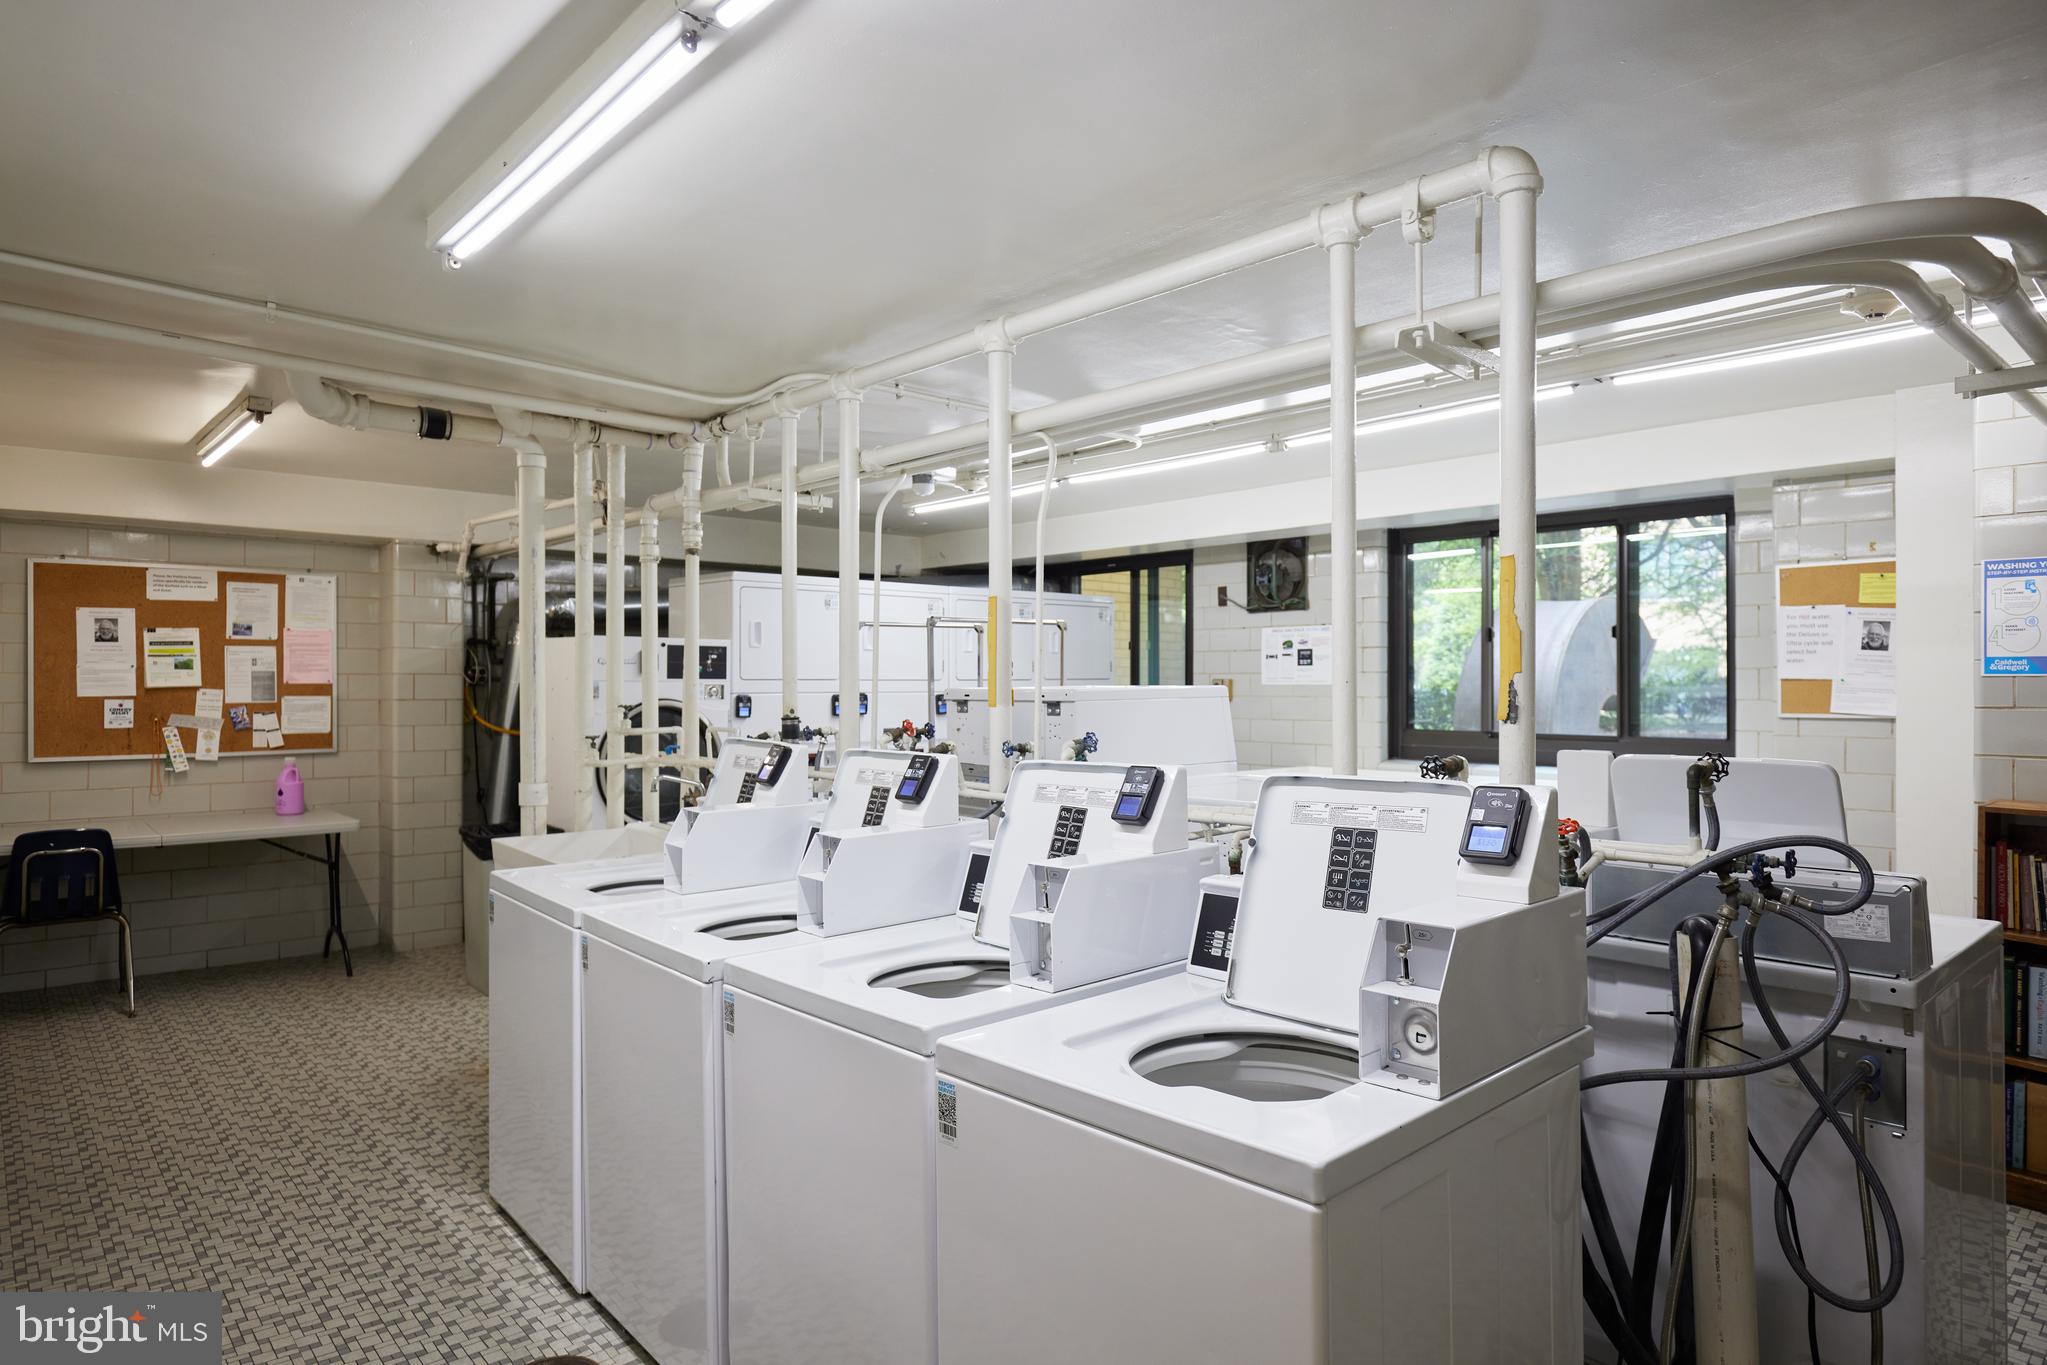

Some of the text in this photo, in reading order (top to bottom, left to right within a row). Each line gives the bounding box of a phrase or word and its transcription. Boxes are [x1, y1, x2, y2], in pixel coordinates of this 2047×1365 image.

[1987, 561, 2037, 570] WASHING
[938, 1080, 956, 1090] REPORT
[938, 1086, 956, 1096] SERVICE
